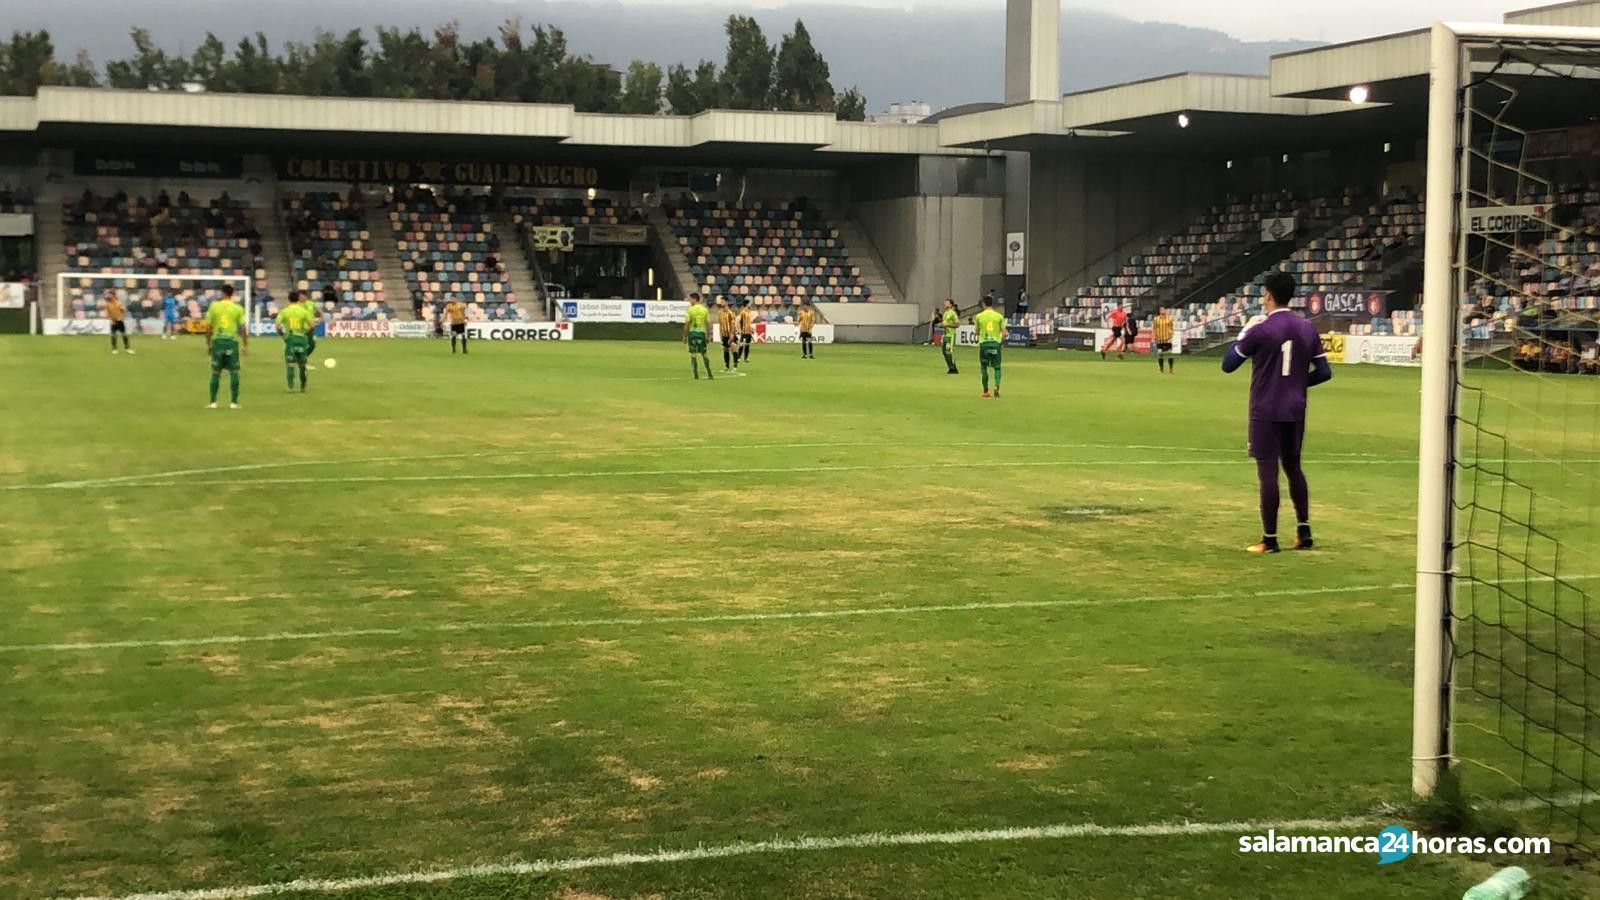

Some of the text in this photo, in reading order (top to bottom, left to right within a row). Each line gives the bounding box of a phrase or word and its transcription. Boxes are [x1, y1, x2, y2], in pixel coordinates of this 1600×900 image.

[287, 159, 599, 186] COLECTIVO GUALDINEGRO
[1471, 215, 1485, 232] EL
[1324, 293, 1364, 312] GASCA
[340, 321, 390, 331] MUEBLES
[467, 328, 562, 340] EL CORREO
[960, 330, 969, 344] EL
[1280, 339, 1293, 377] 1
